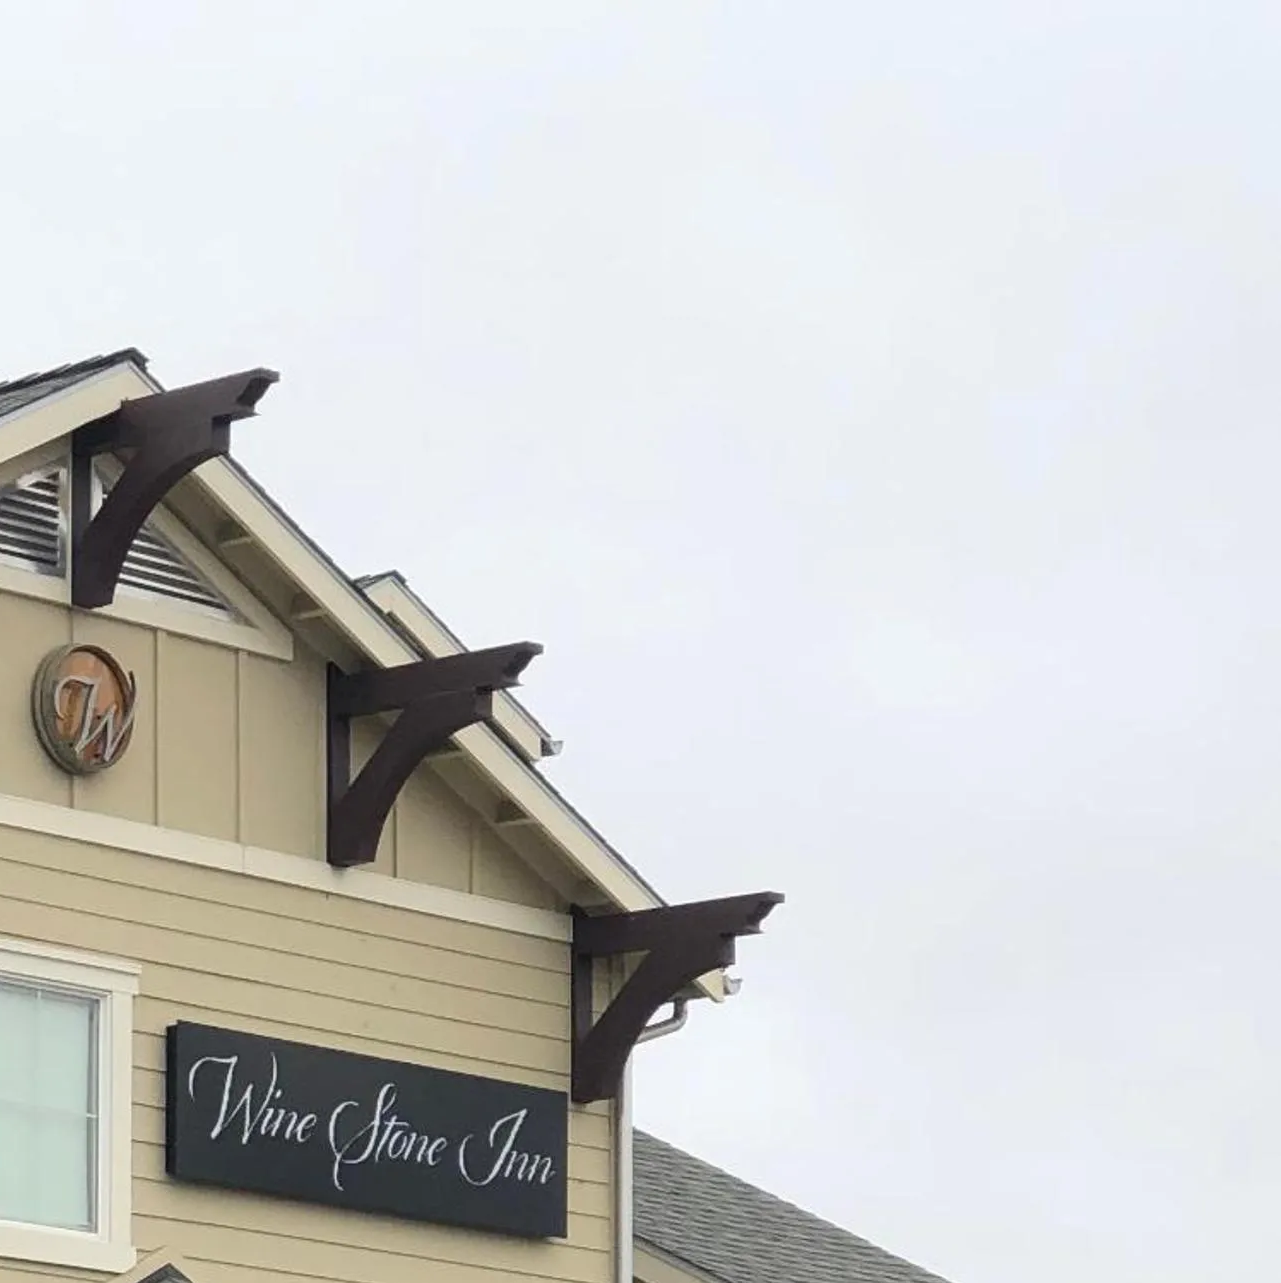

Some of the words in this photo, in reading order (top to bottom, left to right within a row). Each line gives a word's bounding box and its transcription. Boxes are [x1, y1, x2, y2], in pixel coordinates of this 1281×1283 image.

[189, 1051, 317, 1145] Wine
[328, 1083, 448, 1192] Stone
[458, 1108, 556, 1186] Inn
